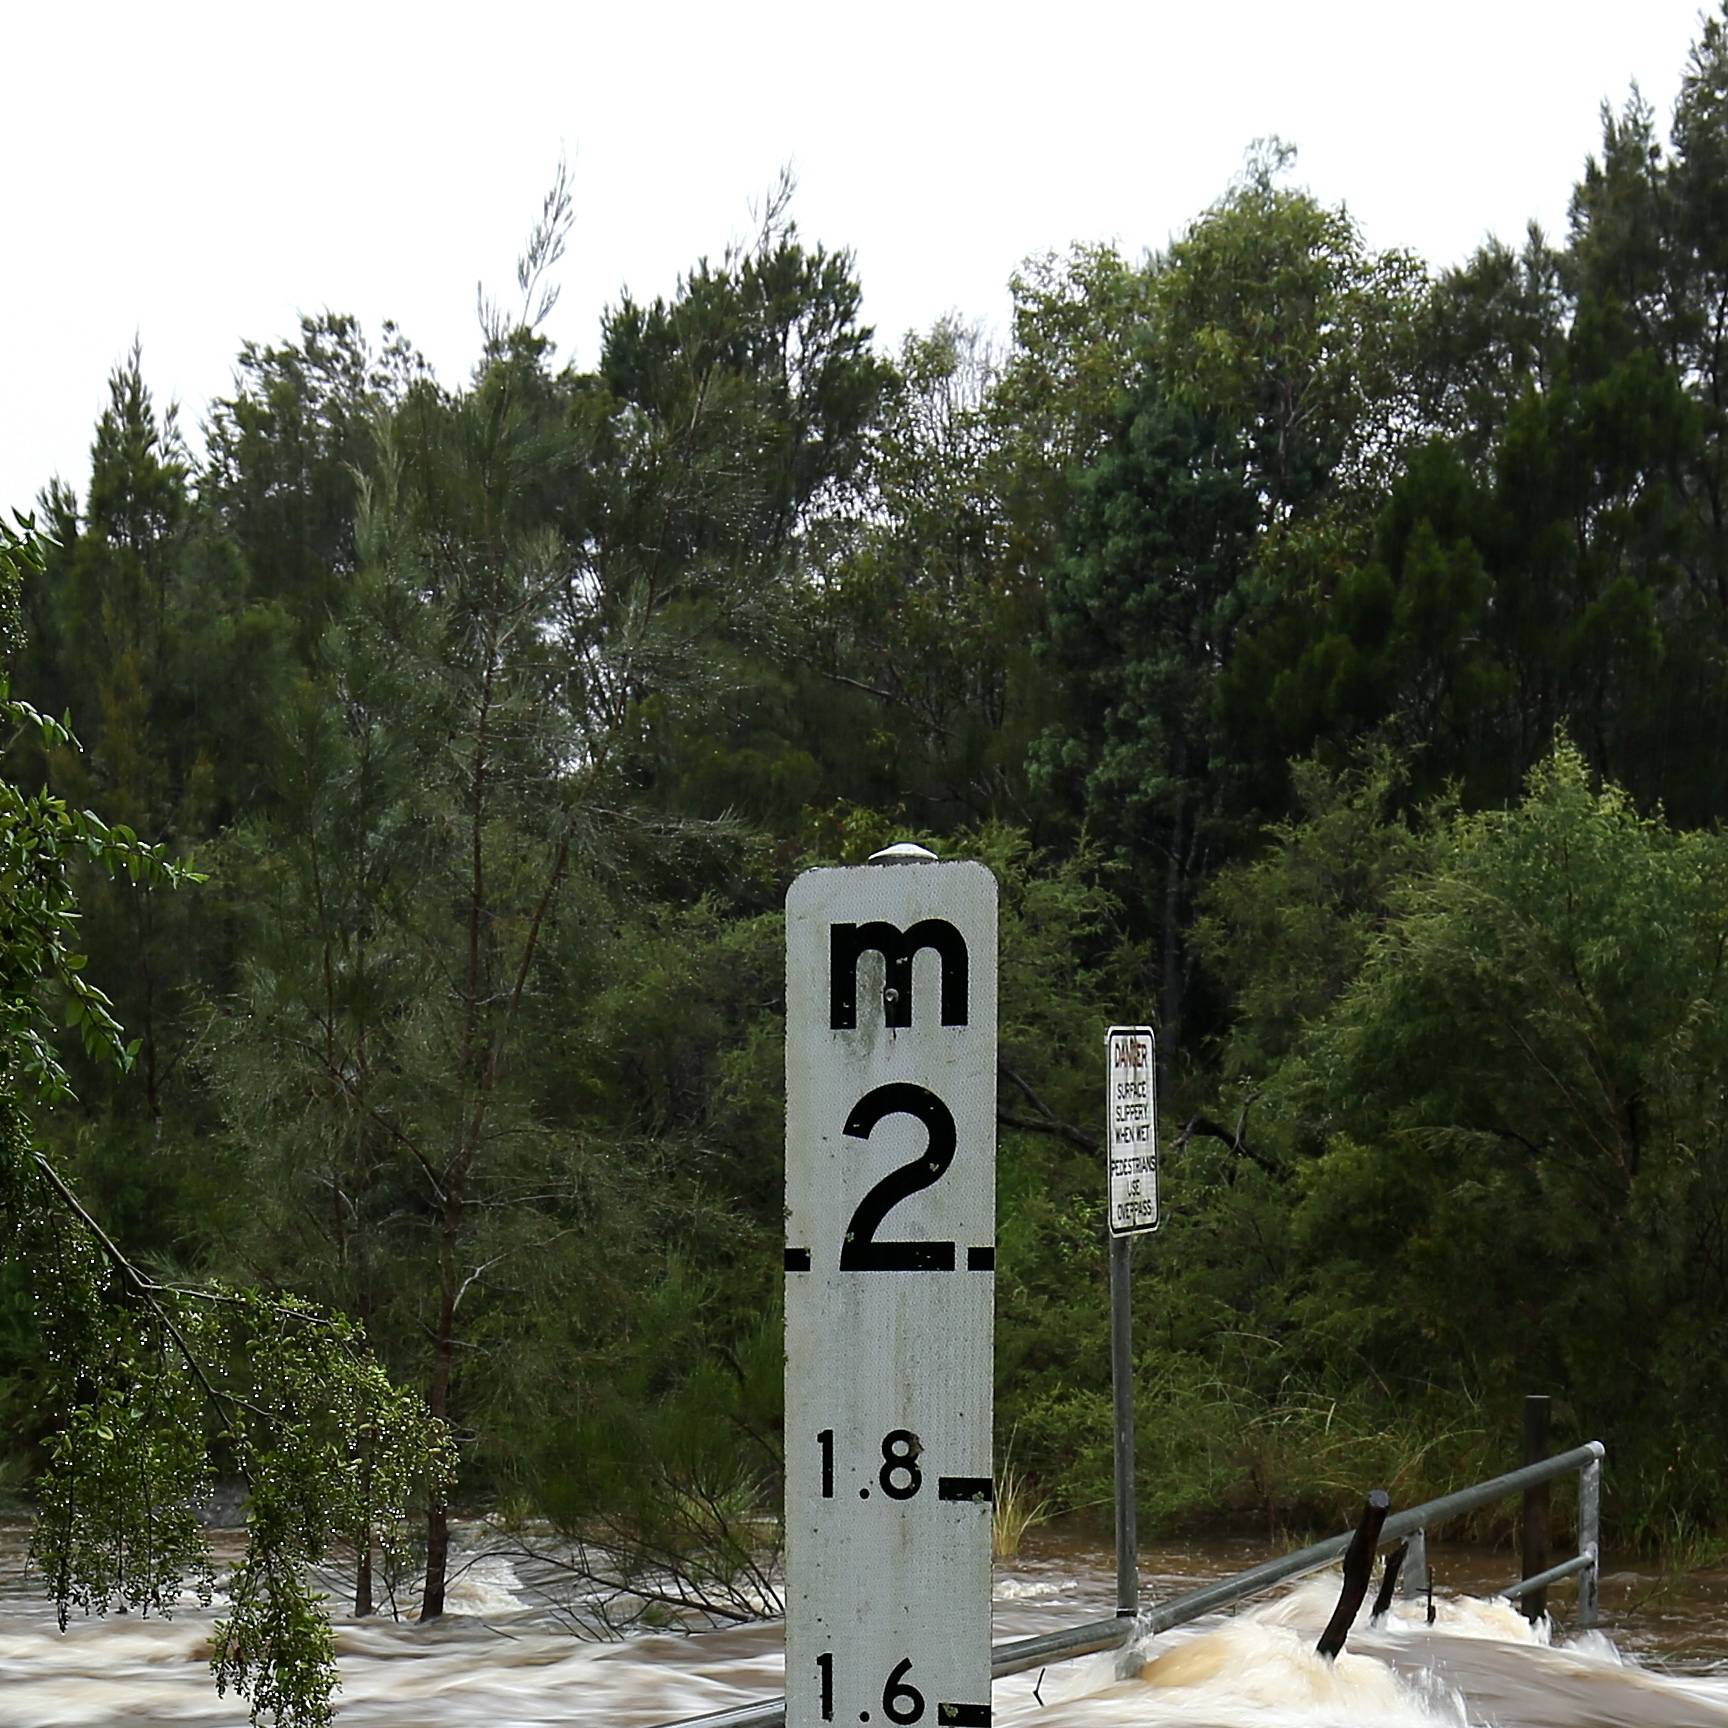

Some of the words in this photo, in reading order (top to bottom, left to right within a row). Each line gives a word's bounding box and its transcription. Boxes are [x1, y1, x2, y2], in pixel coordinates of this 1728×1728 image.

[829, 918, 969, 1030] m
[1117, 1081, 1147, 1100] SURFACE
[1115, 1103, 1148, 1122] SLIPPERY
[1115, 1126, 1135, 1144] WHEN
[1135, 1125, 1151, 1142] WET
[839, 1082, 957, 1272] 2
[1111, 1155, 1156, 1177] PEDESTRIANS
[1127, 1179, 1141, 1197] USE
[1117, 1199, 1152, 1221] OVERPASS
[816, 1429, 925, 1501] 1.8
[816, 1652, 926, 1726] 1.6
